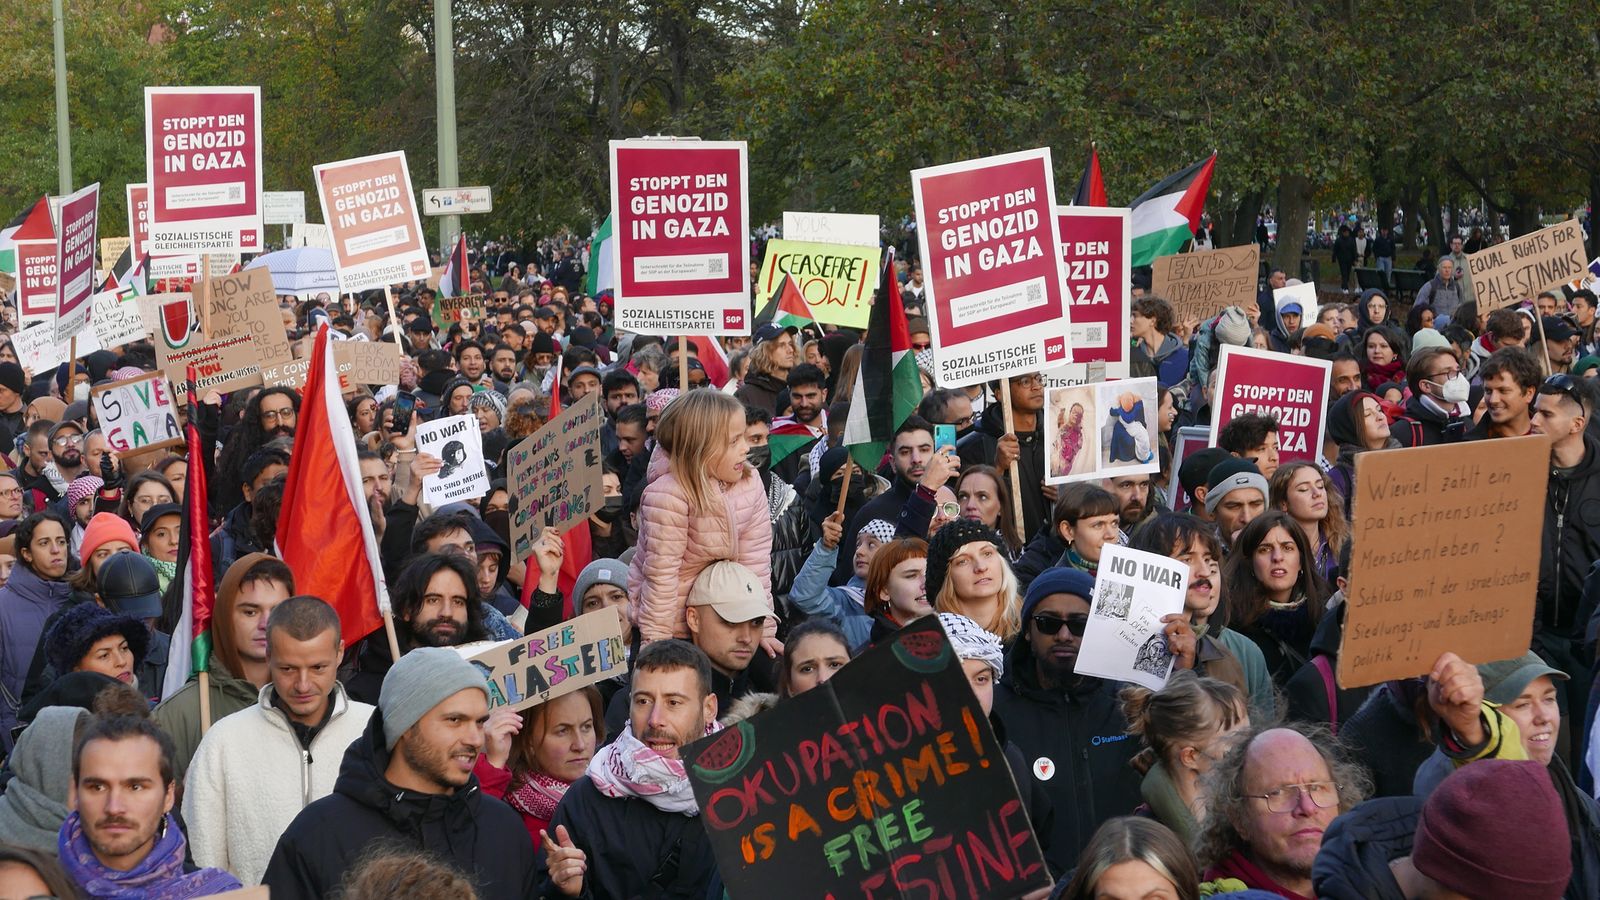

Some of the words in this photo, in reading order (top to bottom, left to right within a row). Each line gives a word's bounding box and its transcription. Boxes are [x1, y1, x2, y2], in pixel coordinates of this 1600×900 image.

[163, 116, 215, 131] STOPPT
[218, 114, 245, 127] DEN
[163, 130, 246, 151] GENOZID
[164, 154, 186, 173] IN
[192, 150, 246, 171] GAZA
[332, 178, 372, 197] STOPPT
[375, 173, 397, 186] DEN
[630, 175, 691, 191] STOPPT
[695, 173, 727, 187] DEN
[335, 186, 400, 212] GENOZID
[630, 192, 729, 215] GENOZID
[938, 195, 1000, 224] STOPPT
[1004, 187, 1036, 209] DEN
[65, 215, 85, 236] STOPPT
[339, 212, 357, 229] IN
[361, 201, 405, 223] GAZA
[65, 224, 93, 254] GENOZID
[155, 231, 233, 241] SOZIALISTISCHE
[632, 219, 656, 240] IN
[664, 216, 730, 238] GAZA
[941, 208, 1039, 251] GENOZID
[155, 241, 234, 250] GLEICHHEITSPARTEI
[1075, 241, 1109, 256] DEN
[1469, 251, 1508, 275] EQUAL
[1511, 233, 1549, 260] RIGHTS
[1552, 226, 1576, 246] FOR
[25, 255, 56, 265] STOPPT
[64, 255, 73, 272] IN
[74, 243, 92, 266] GAZA
[944, 253, 972, 280] IN
[978, 236, 1044, 271] GAZA
[1168, 253, 1233, 281] END
[25, 264, 57, 276] GENO
[344, 264, 407, 282] SOZIALISTISCHE
[1475, 249, 1583, 308] PALESTINANS
[26, 277, 40, 289] IN
[43, 276, 58, 288] GA
[212, 274, 252, 297] HOW
[244, 290, 273, 307] ARE
[440, 297, 465, 311] NEVER
[227, 309, 249, 324] YOU
[622, 309, 715, 320] SOZIALISTISCHE
[622, 320, 715, 330] GLEICHHEITSPARTEI
[246, 320, 265, 335] TO
[942, 343, 1037, 371] SOZIALISTISCHE
[1047, 343, 1063, 355] SGP
[198, 362, 222, 377] YOU
[263, 363, 279, 380] WE
[355, 355, 396, 369] FROM
[943, 355, 1038, 382] GLEICHHEITSPARTEI
[353, 368, 400, 383] OCIDE
[101, 378, 170, 422] SAVE
[175, 382, 188, 395] AR
[1233, 384, 1285, 401] STOPPT
[1287, 389, 1313, 404] DEN
[107, 412, 180, 452] GAZA
[421, 431, 438, 445] NO
[440, 420, 467, 439] WAR
[444, 481, 461, 490] SIND
[463, 470, 485, 484] MEINE
[1367, 464, 1429, 501] Wieviel
[1441, 464, 1480, 492] zählt
[1488, 468, 1512, 485] ein
[444, 485, 476, 499] KINDER?
[1363, 497, 1519, 541] palästinensisches
[1361, 536, 1480, 570] Menschenleben
[1495, 523, 1506, 553] ?
[1110, 556, 1138, 578] NO
[1142, 563, 1183, 590] WAR
[1356, 584, 1404, 607] Schluss
[1413, 575, 1436, 598] mit
[1441, 576, 1458, 594] der
[1465, 566, 1531, 592] israelischen
[508, 625, 575, 666] FREE
[1352, 645, 1393, 672] politik
[706, 681, 942, 831] OKUPATION
[741, 822, 776, 865] IS
[788, 803, 823, 842] A
[827, 706, 991, 821] CRIME!
[823, 798, 934, 878] FREE
[824, 799, 1042, 900] STINE
